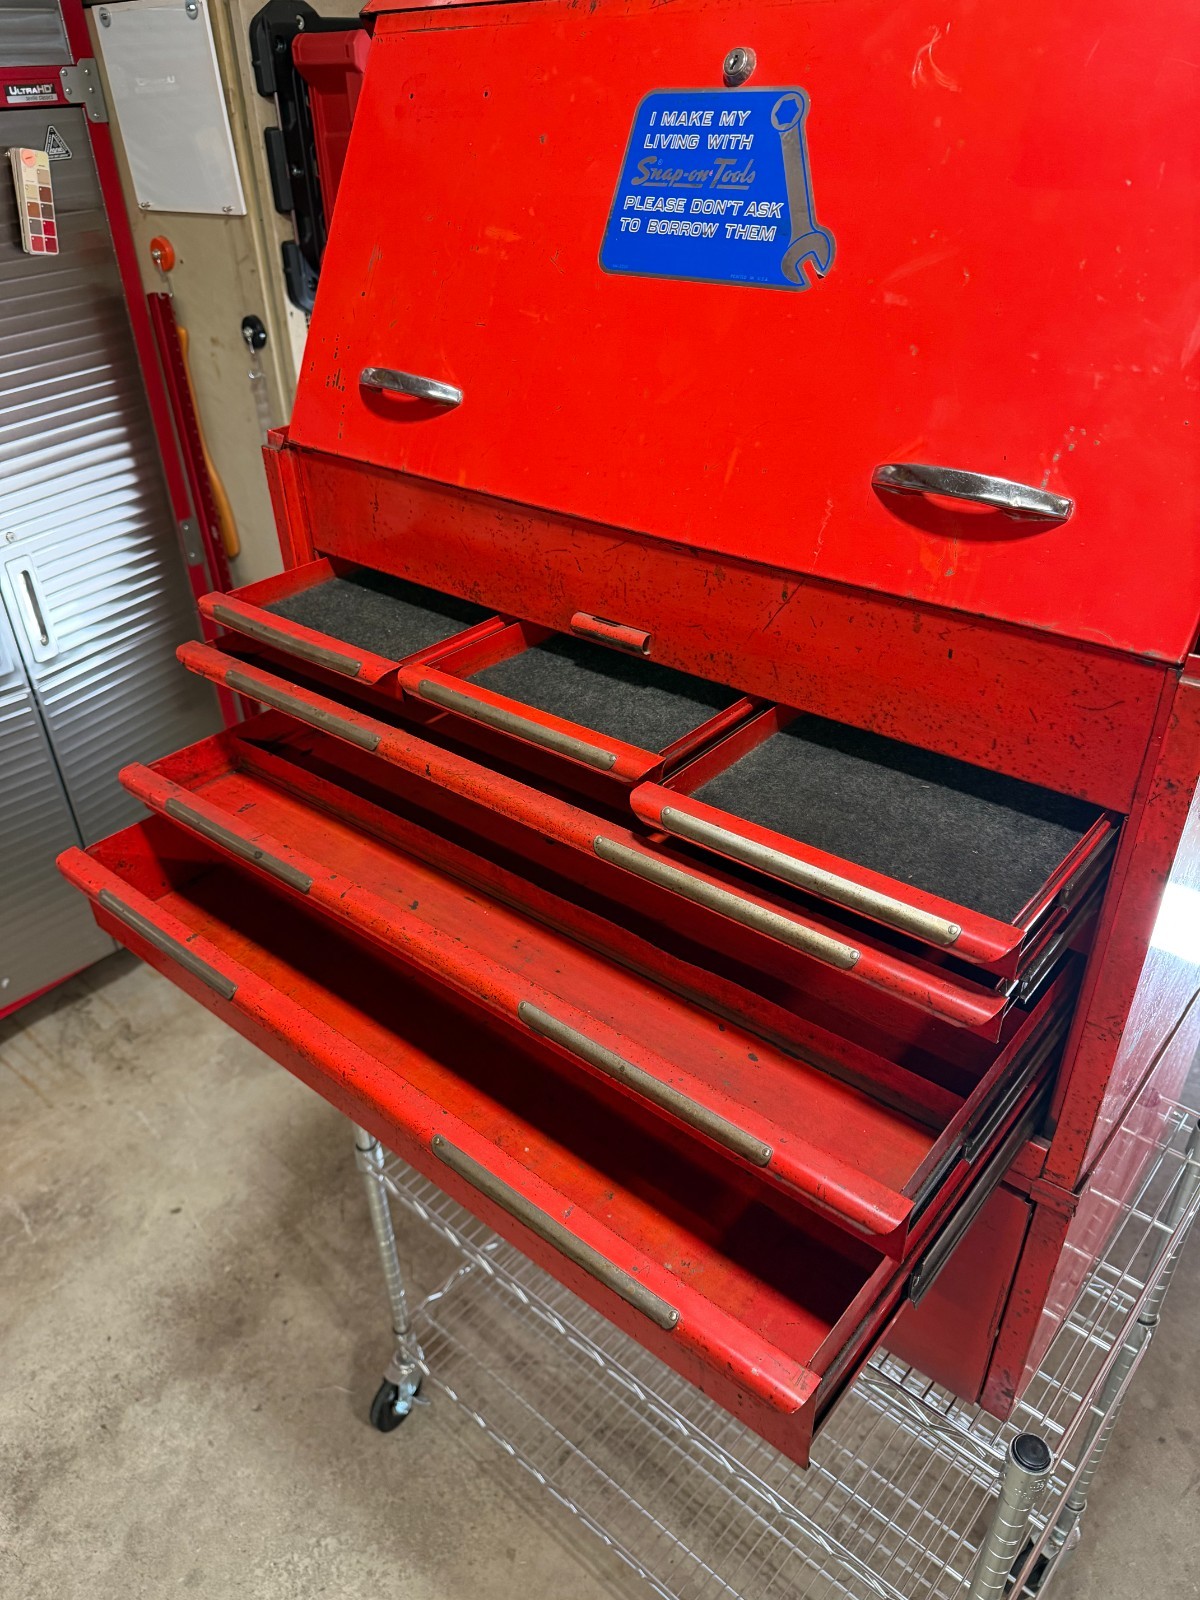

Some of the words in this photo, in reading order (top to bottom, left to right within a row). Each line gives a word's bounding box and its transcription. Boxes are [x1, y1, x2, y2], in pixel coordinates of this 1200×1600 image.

[649, 111, 657, 126] I
[660, 111, 714, 127] MAKE
[719, 110, 751, 127] MY
[643, 134, 700, 149] LIVING
[707, 134, 754, 150] WITH
[631, 156, 707, 187] Snap-on
[709, 157, 756, 189] Tools
[623, 195, 686, 213] PLEASE
[690, 198, 743, 216] DON'T
[743, 201, 784, 218] ASK
[620, 217, 641, 233] TO
[646, 219, 719, 238] BORROW
[725, 223, 777, 242] THEM
